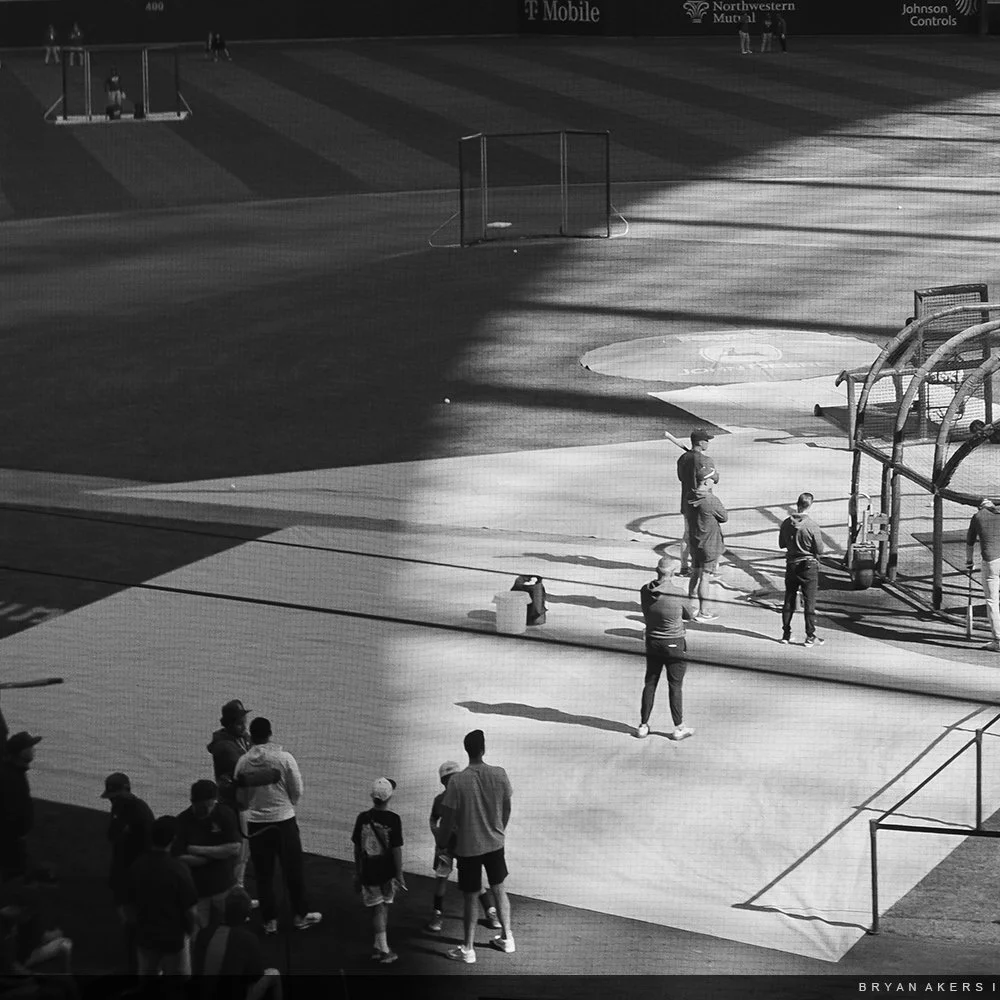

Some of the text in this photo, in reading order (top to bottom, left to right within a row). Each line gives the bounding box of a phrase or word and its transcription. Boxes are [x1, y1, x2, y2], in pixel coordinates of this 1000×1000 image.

[145, 1, 164, 11] 400
[542, 0, 600, 22] Mobile
[713, 0, 796, 12] Northwestern
[902, 3, 948, 15] Johnson
[910, 16, 957, 27] Controls
